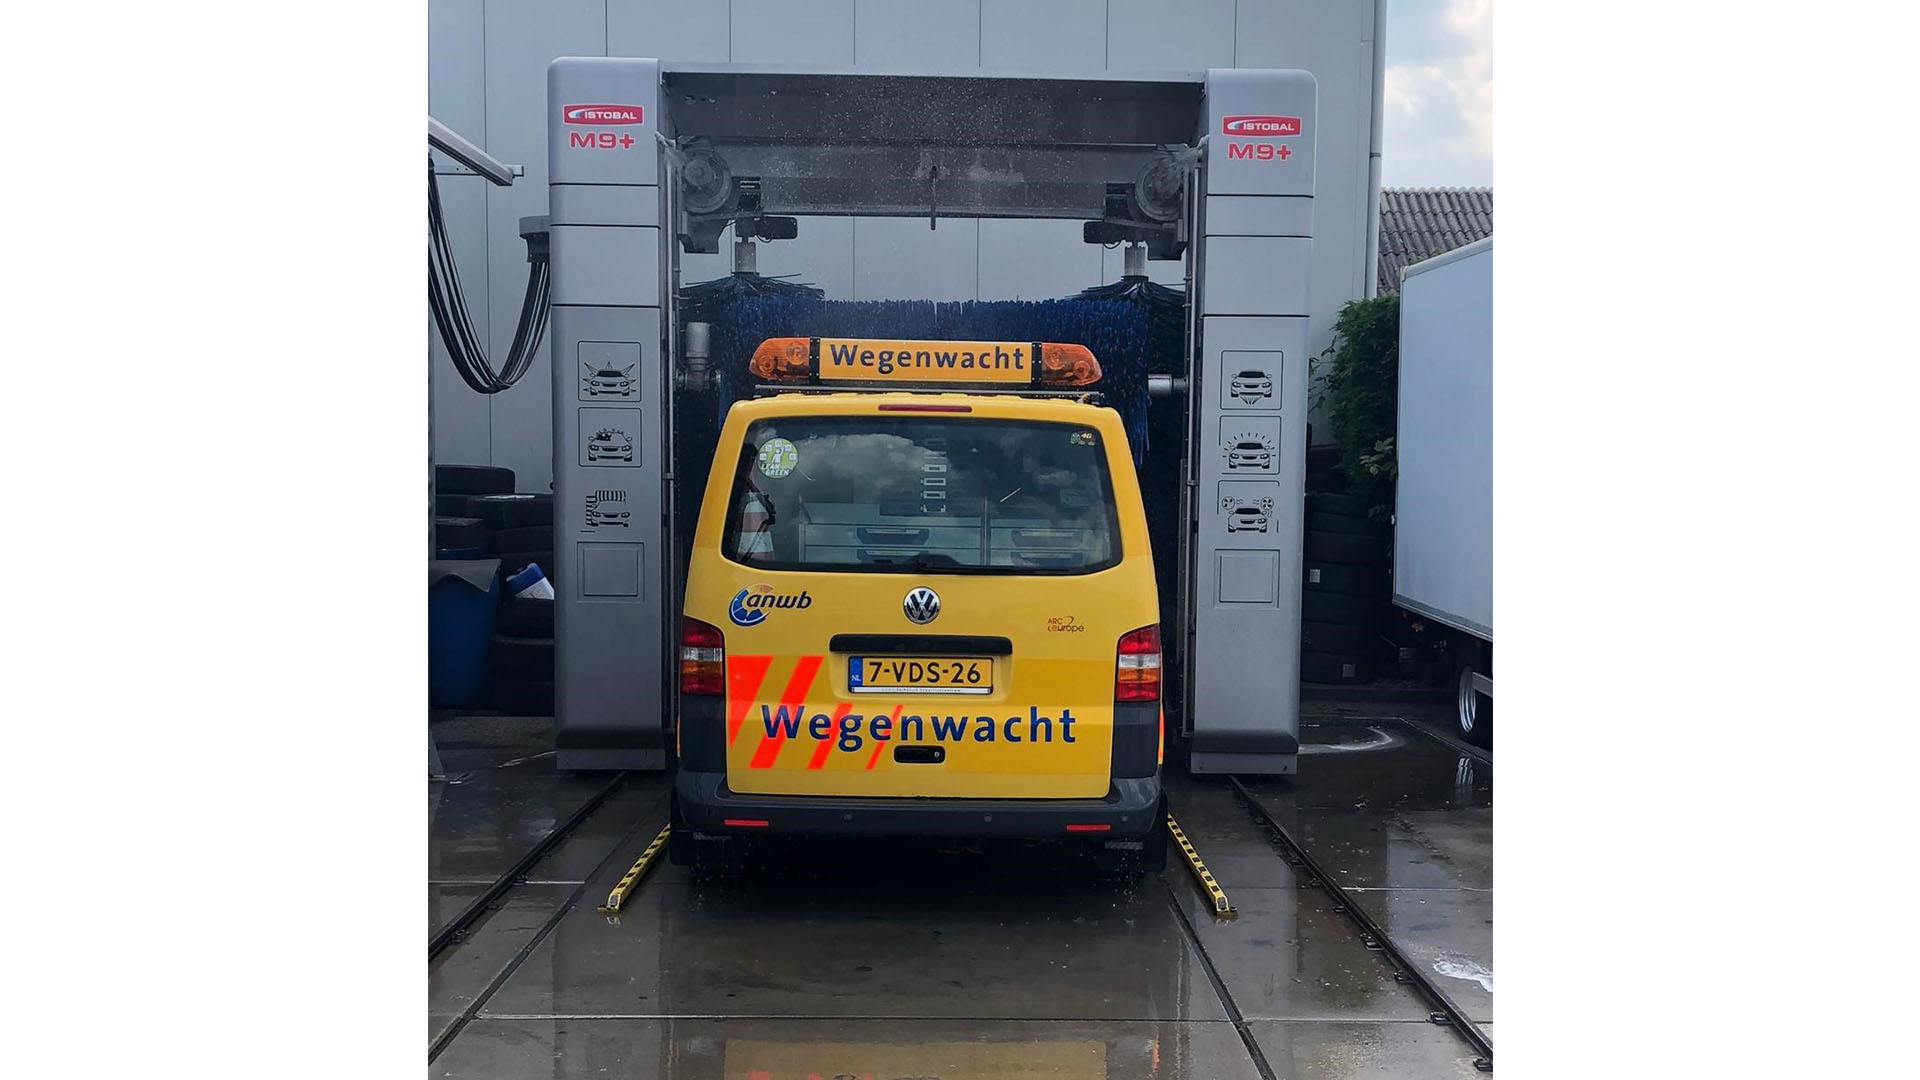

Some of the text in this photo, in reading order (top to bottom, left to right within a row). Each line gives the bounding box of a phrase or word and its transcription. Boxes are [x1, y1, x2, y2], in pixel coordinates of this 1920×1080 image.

[584, 111, 637, 119] ISTOBAL
[1243, 123, 1294, 131] ISTOBAL
[570, 132, 634, 149] M9+
[1228, 143, 1292, 160] M9+
[830, 343, 1025, 374] Wegenwacht
[746, 590, 812, 609] anwb
[851, 674, 861, 682] NL
[869, 661, 981, 684] 7-VDS-26
[761, 704, 1076, 752] Wegenwacht
